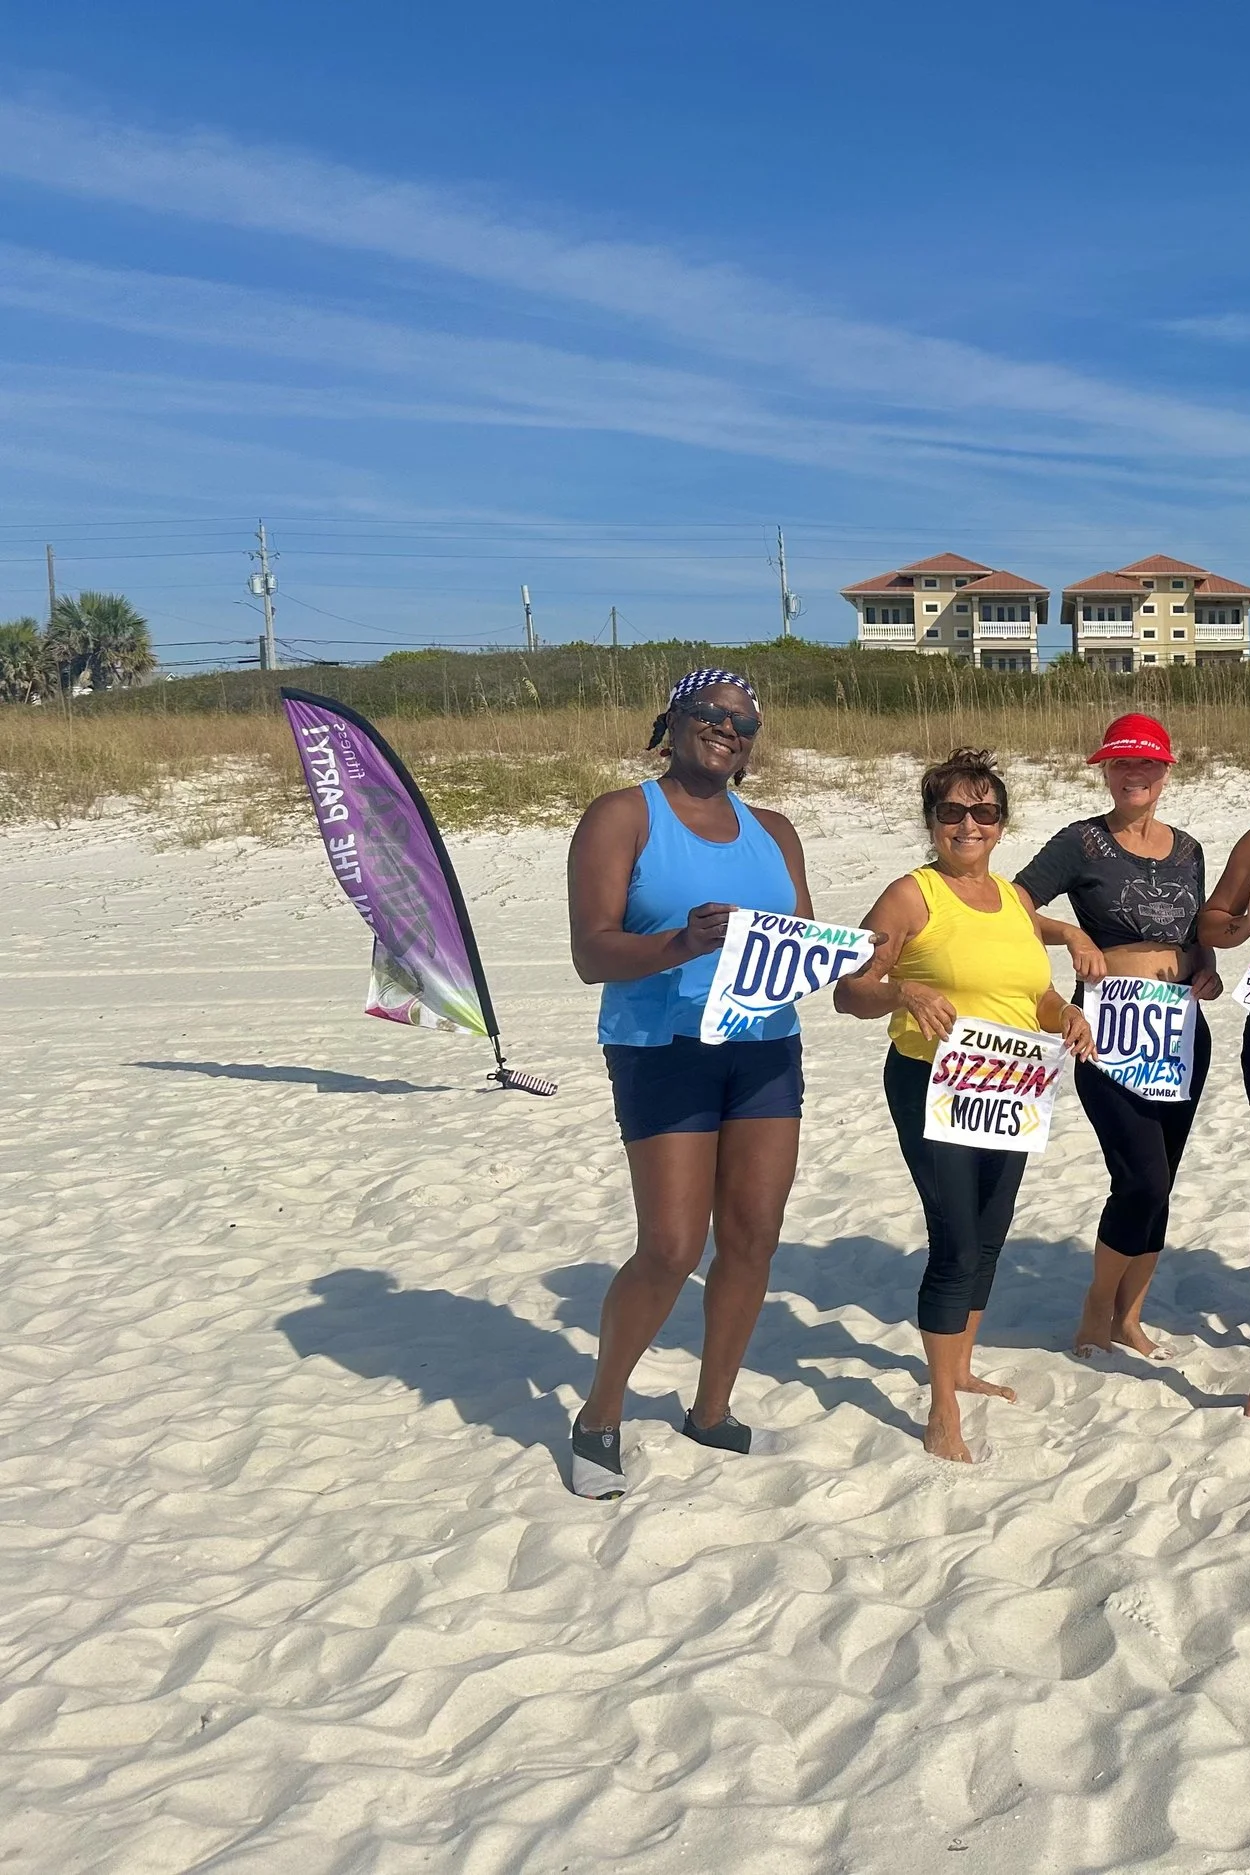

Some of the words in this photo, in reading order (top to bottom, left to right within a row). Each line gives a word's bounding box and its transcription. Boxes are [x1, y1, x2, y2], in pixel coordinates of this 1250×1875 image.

[750, 911, 807, 938] YOUR
[803, 924, 865, 948] DAILY
[1100, 980, 1144, 1001] YOUR
[1138, 981, 1189, 1005] DAILY
[960, 1028, 1043, 1061] ZUMBA
[1096, 1002, 1182, 1062] DOSE
[932, 1050, 1060, 1098] SIZZLIN
[1142, 1087, 1177, 1098] ZUMBA
[950, 1094, 1023, 1137] MOVES
